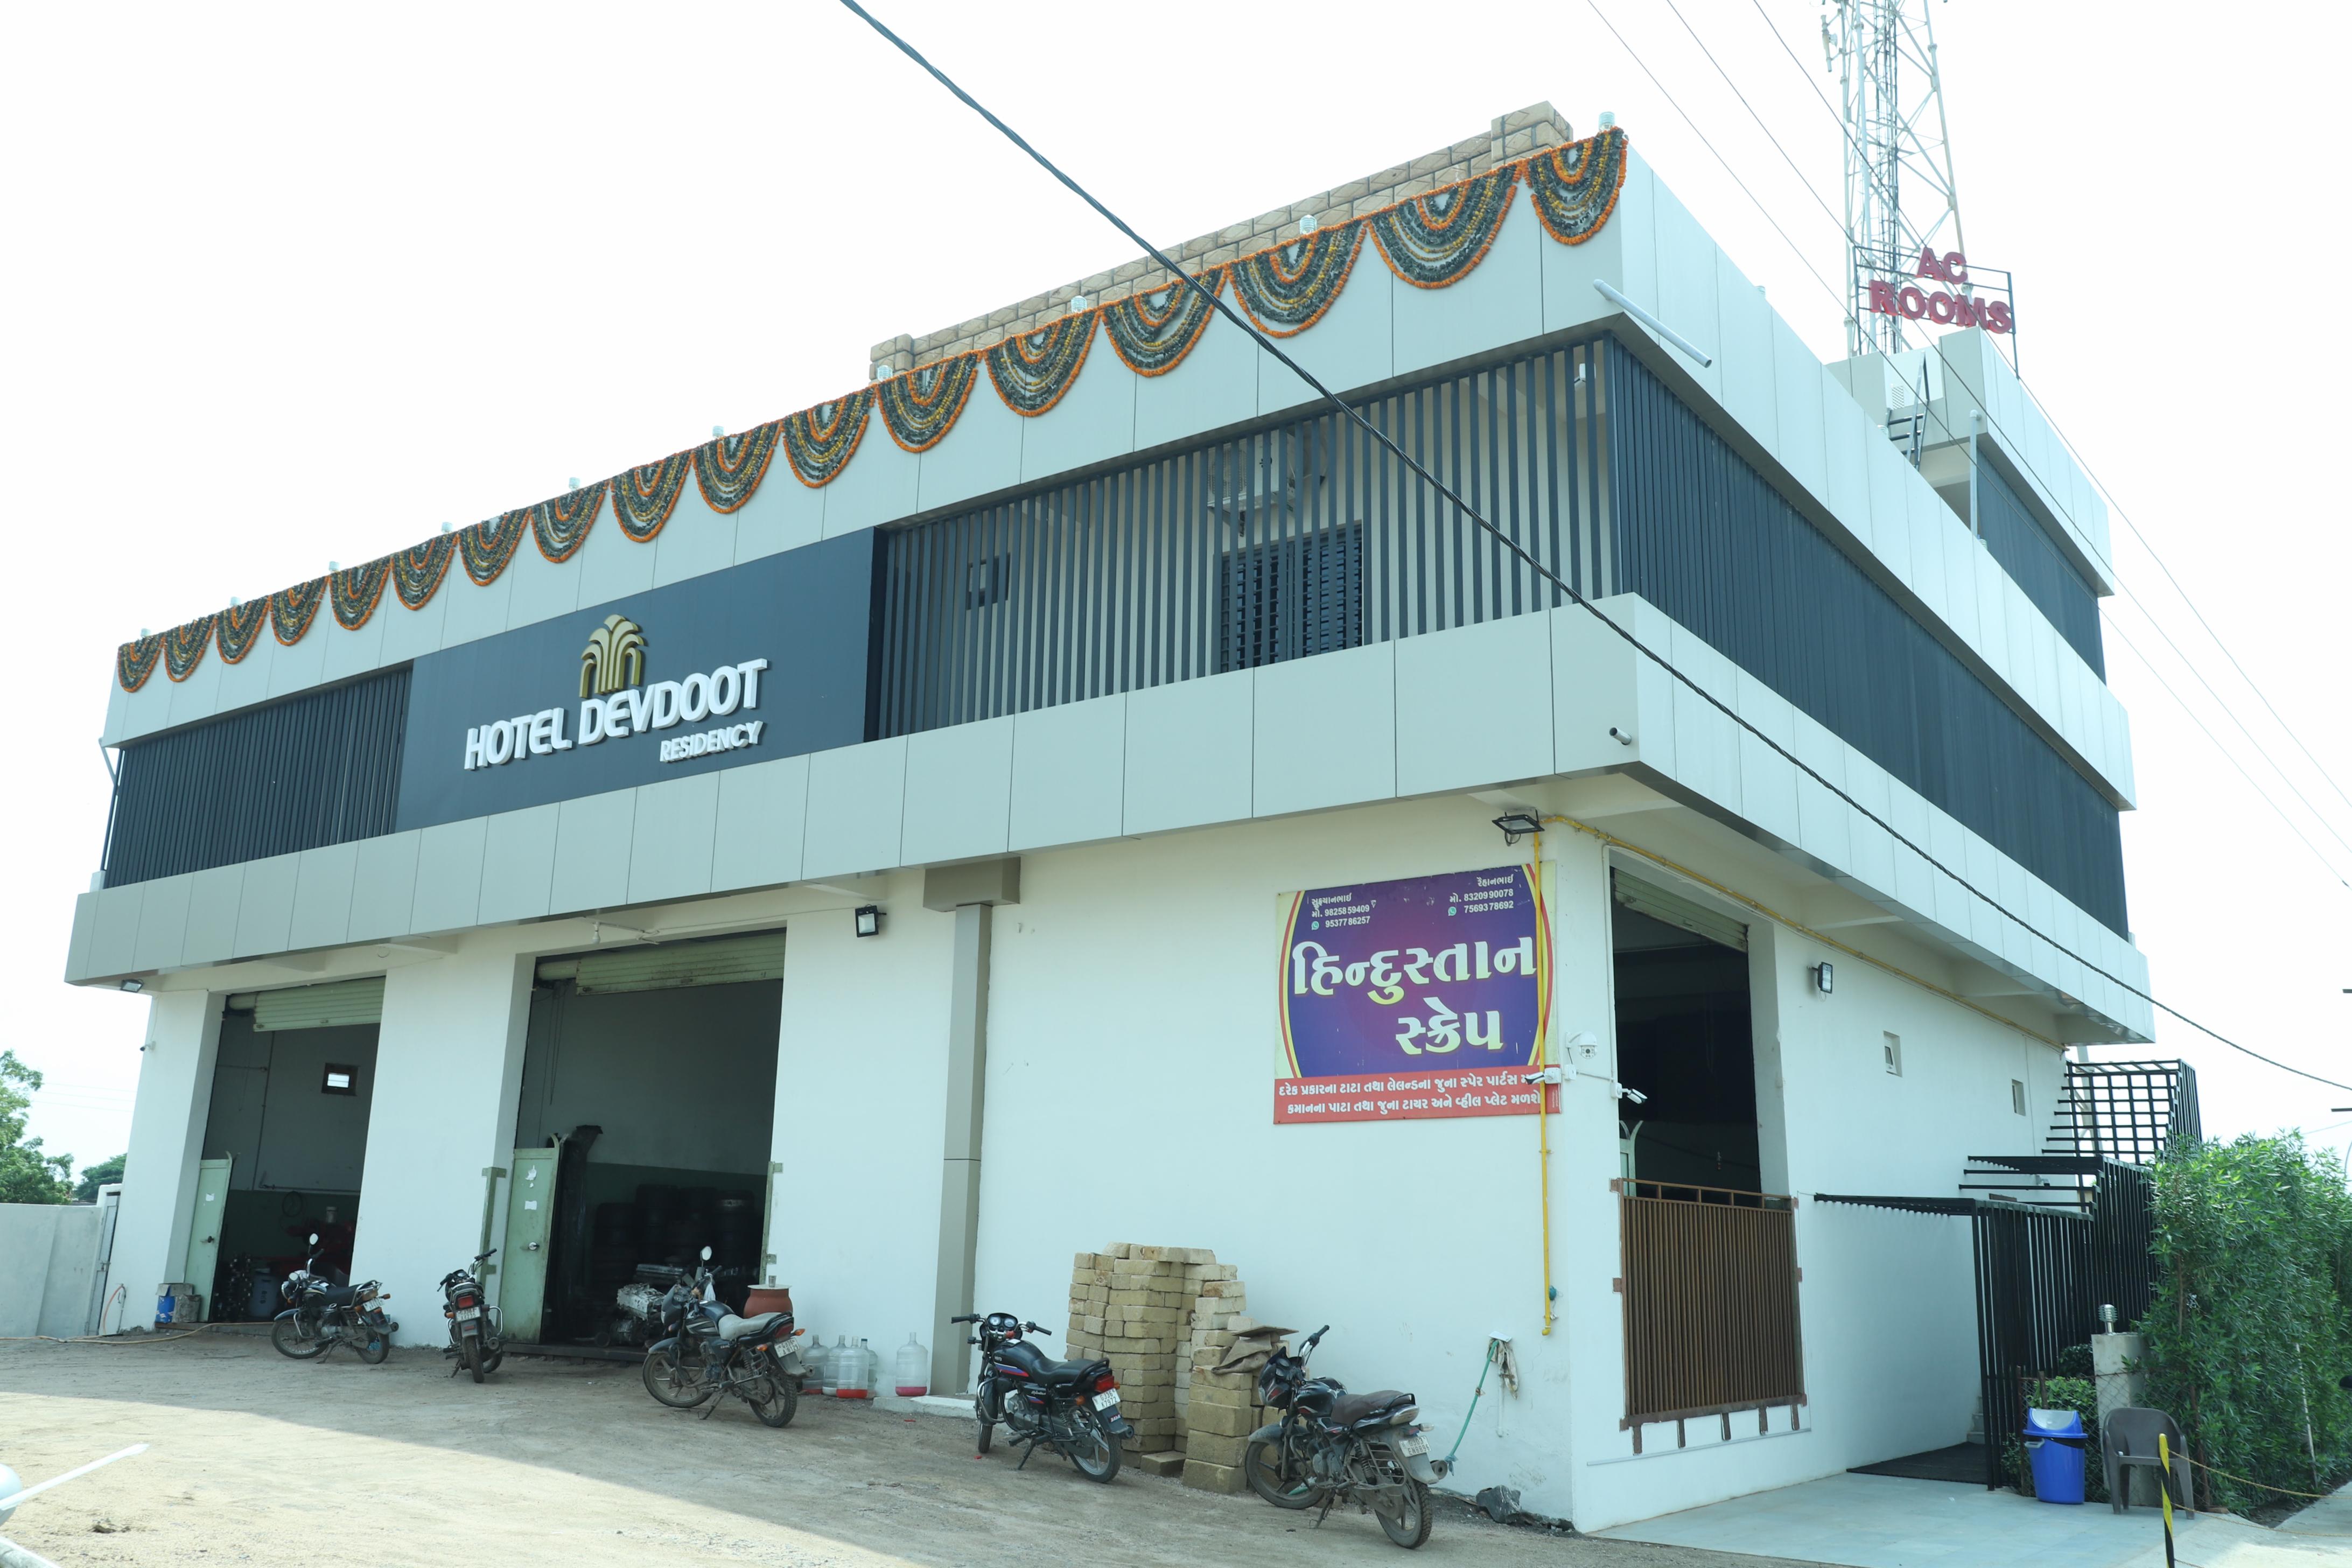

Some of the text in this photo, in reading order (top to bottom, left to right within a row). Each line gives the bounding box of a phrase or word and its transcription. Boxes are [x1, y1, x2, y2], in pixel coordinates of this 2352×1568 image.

[1915, 247, 1968, 285] AC
[1869, 279, 2013, 334] ROOMS
[464, 658, 767, 771] HOTEL DEVDOOT
[660, 720, 763, 762] RESIDENCY
[1292, 936, 1537, 1005] હિન્દુસ્તાન
[1396, 997, 1504, 1055] સ્ક્રેપ
[1279, 1082, 1298, 1096] દરેક
[1300, 1083, 1336, 1095] પ્રકારના
[1340, 1083, 1361, 1094] ટાટા
[1363, 1081, 1384, 1092] તથા
[1387, 1077, 1431, 1091] લેલન્ડના
[1434, 1077, 1457, 1093] જુના
[1460, 1073, 1483, 1087] સ્પેર
[1486, 1070, 1517, 1086] પાર્ટસ
[1287, 1103, 1325, 1114] કમાનના
[1328, 1102, 1350, 1113] પાટા
[1354, 1100, 1374, 1111] તથા
[1377, 1100, 1399, 1115] જુના
[1402, 1097, 1429, 1110] ટાયર
[1431, 1094, 1452, 1108] અને
[1455, 1093, 1481, 1108] વ્હીલ
[1485, 1091, 1508, 1106] પ્લેટ
[1511, 1089, 1541, 1104] મળશે
[1100, 1391, 1113, 1401] GJ36
